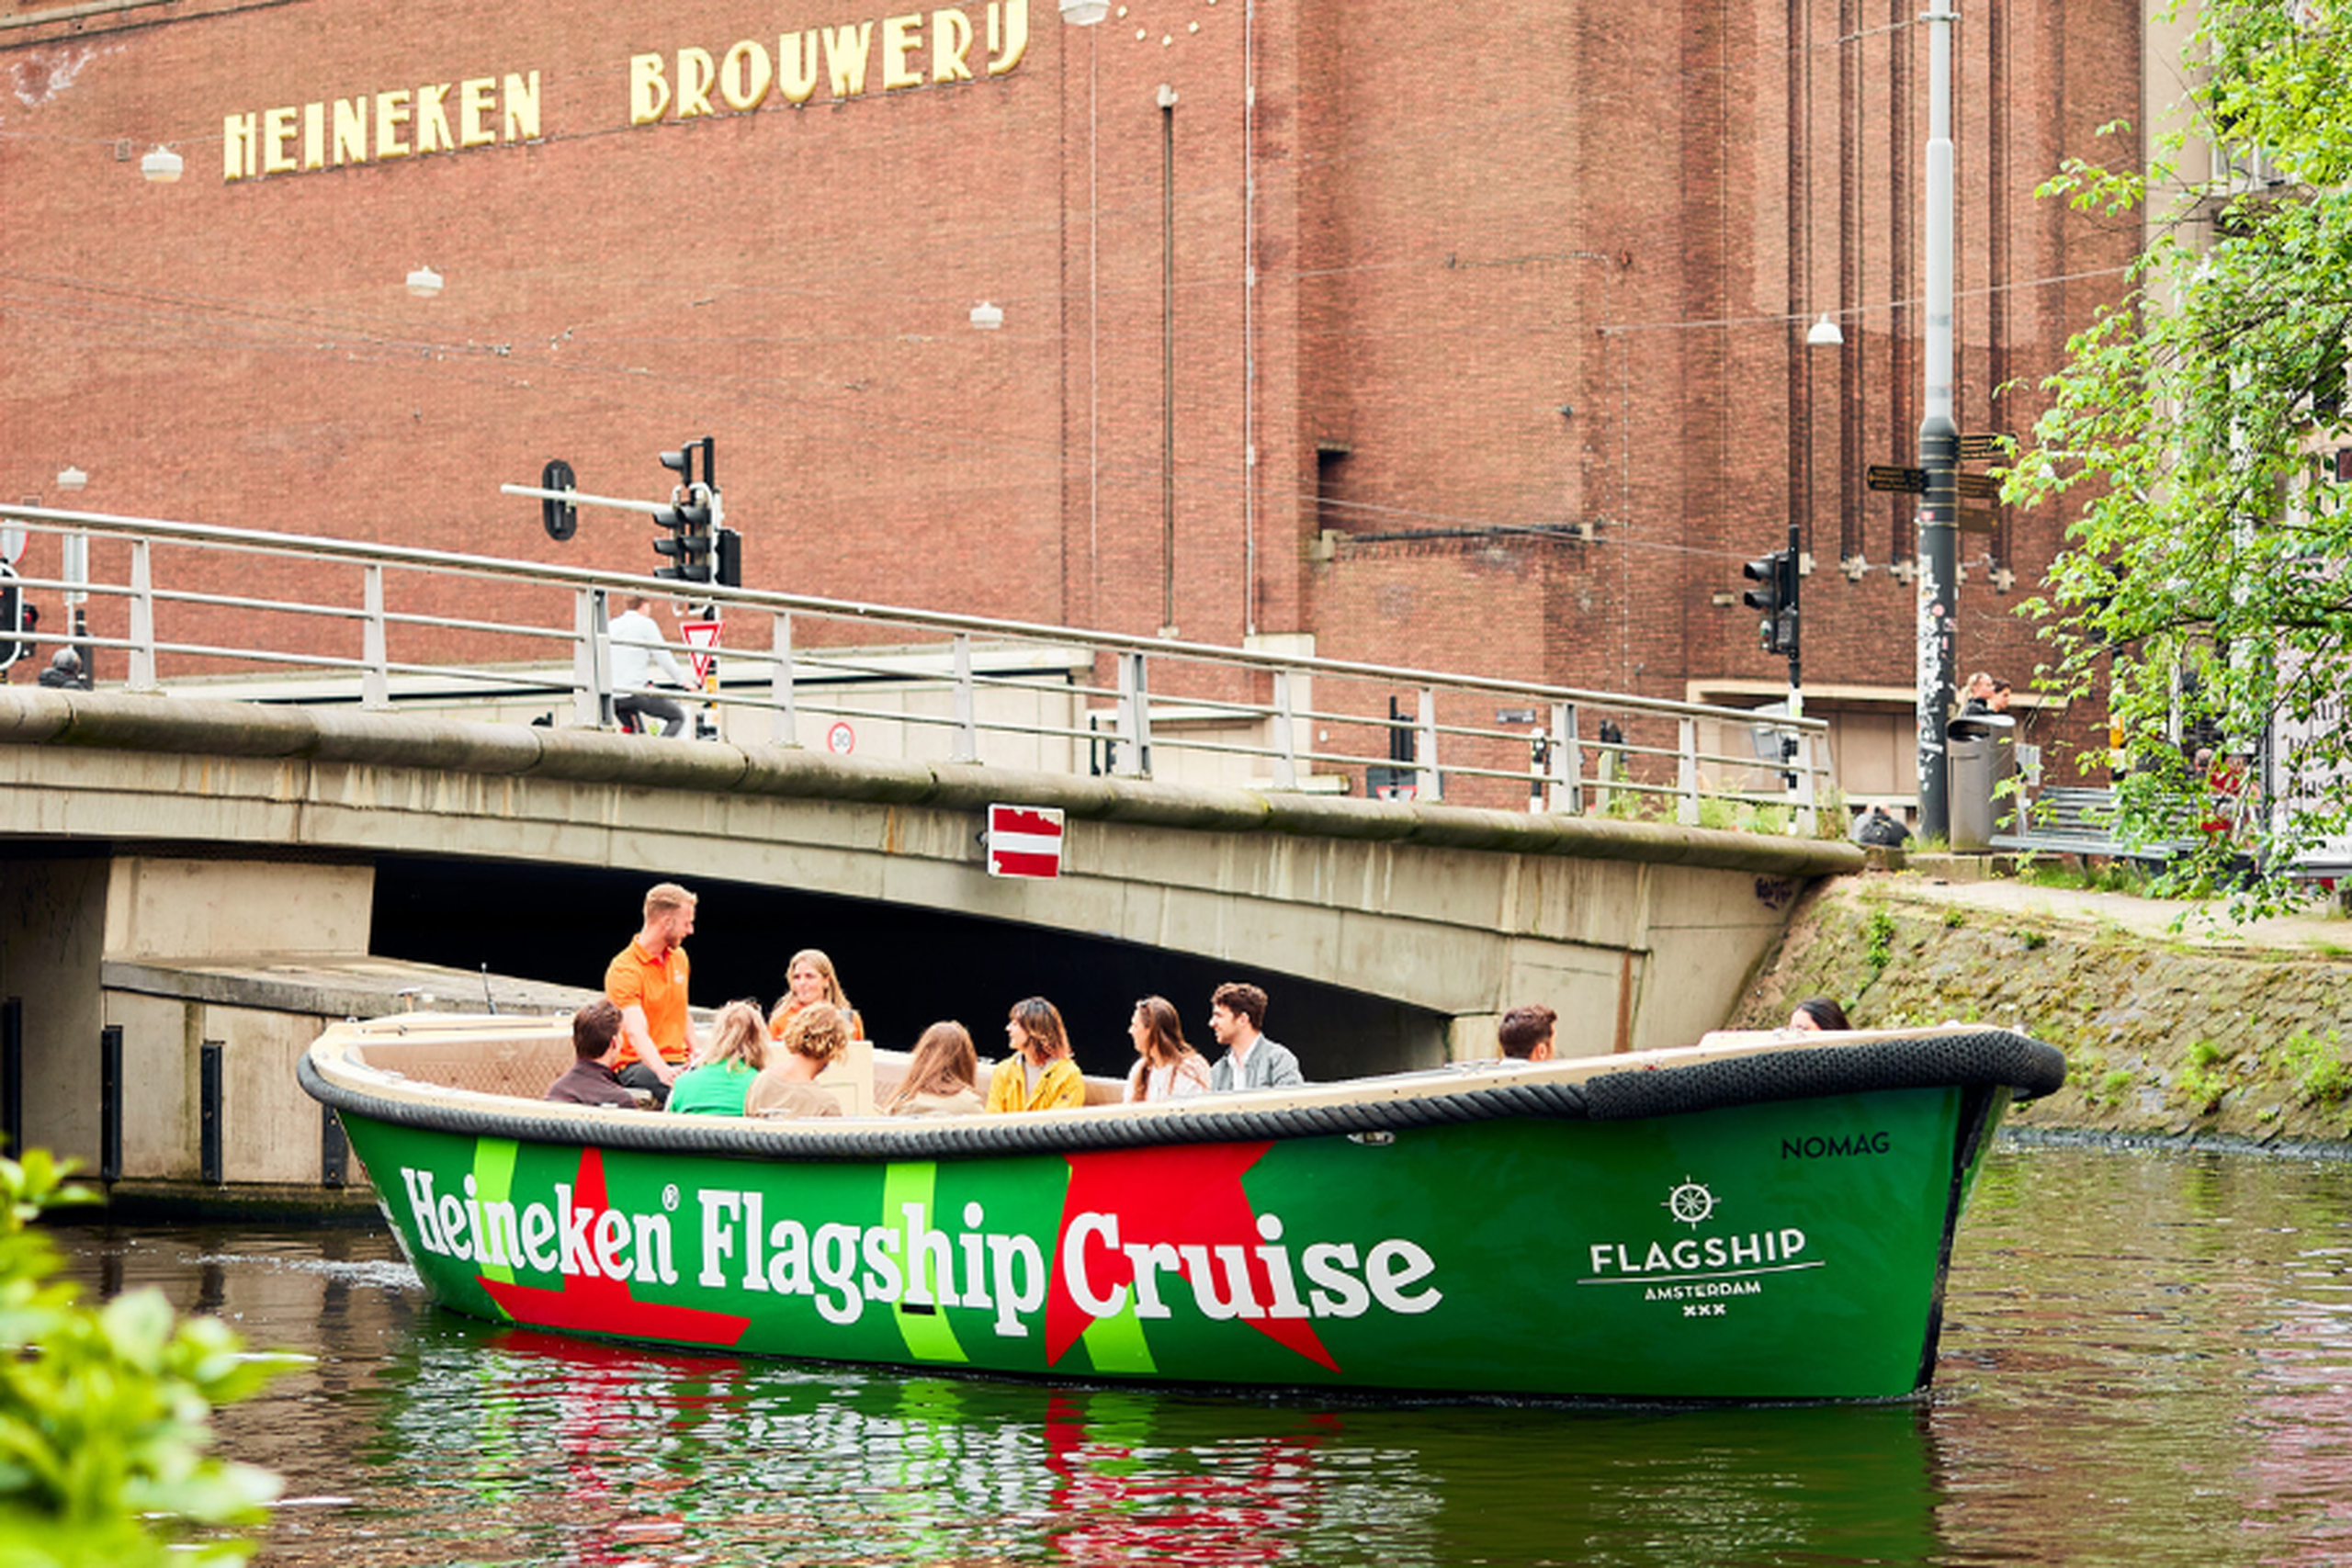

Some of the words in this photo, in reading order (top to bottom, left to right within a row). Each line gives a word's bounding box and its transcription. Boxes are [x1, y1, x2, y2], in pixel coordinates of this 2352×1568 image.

[223, 70, 541, 181] HEINEKEN
[630, 0, 1029, 126] BROUWERIJ
[834, 731, 851, 748] 30
[1781, 1131, 1890, 1160] NOMAG
[698, 1189, 1046, 1337] Flagship
[1063, 1212, 1443, 1320] Cruise
[1590, 1228, 1805, 1273] FLAGSHIP
[1645, 1280, 1761, 1301] AMSTERDAM
